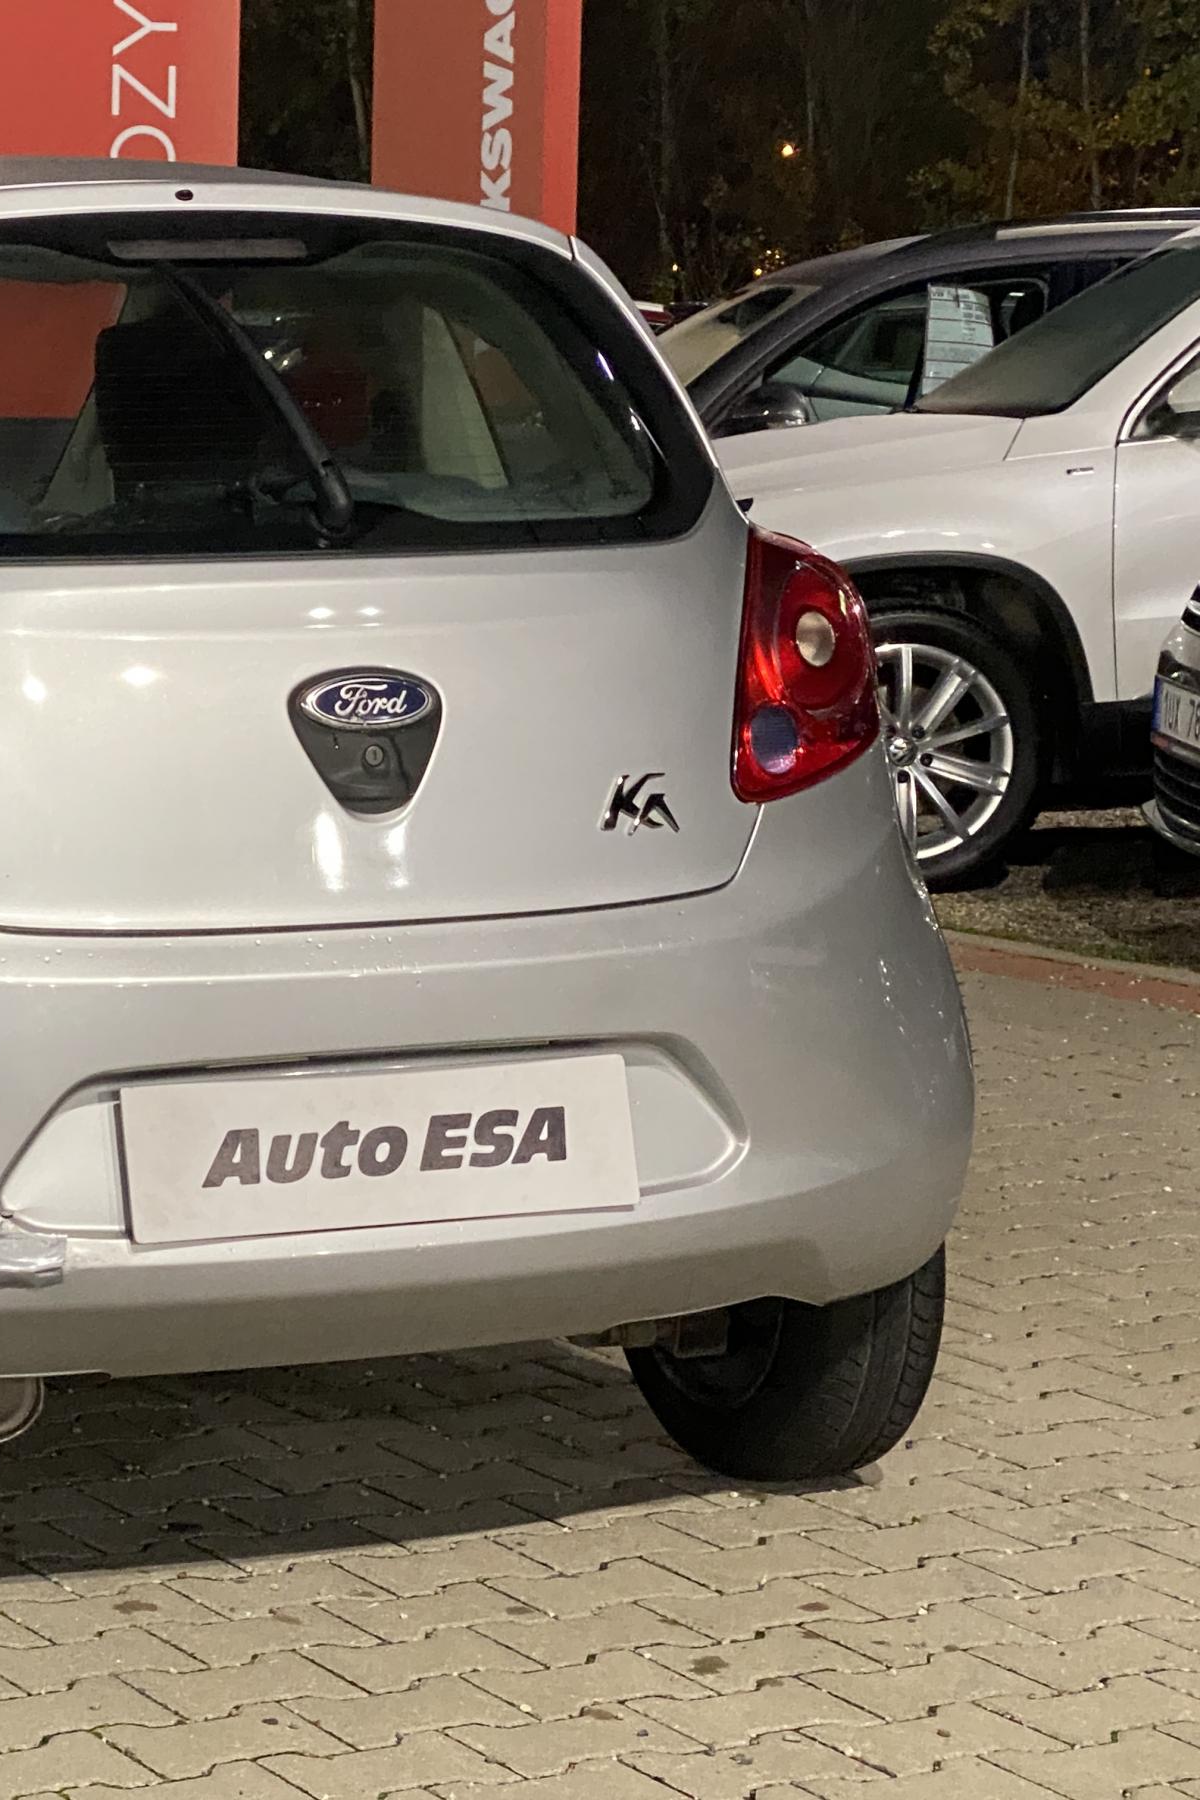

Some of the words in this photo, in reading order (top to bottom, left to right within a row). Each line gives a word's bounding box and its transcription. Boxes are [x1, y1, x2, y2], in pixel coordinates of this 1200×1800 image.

[480, 0, 516, 212] KSWA
[334, 684, 408, 716] Ford
[201, 1121, 408, 1188] Auto
[419, 1106, 567, 1171] ESA
